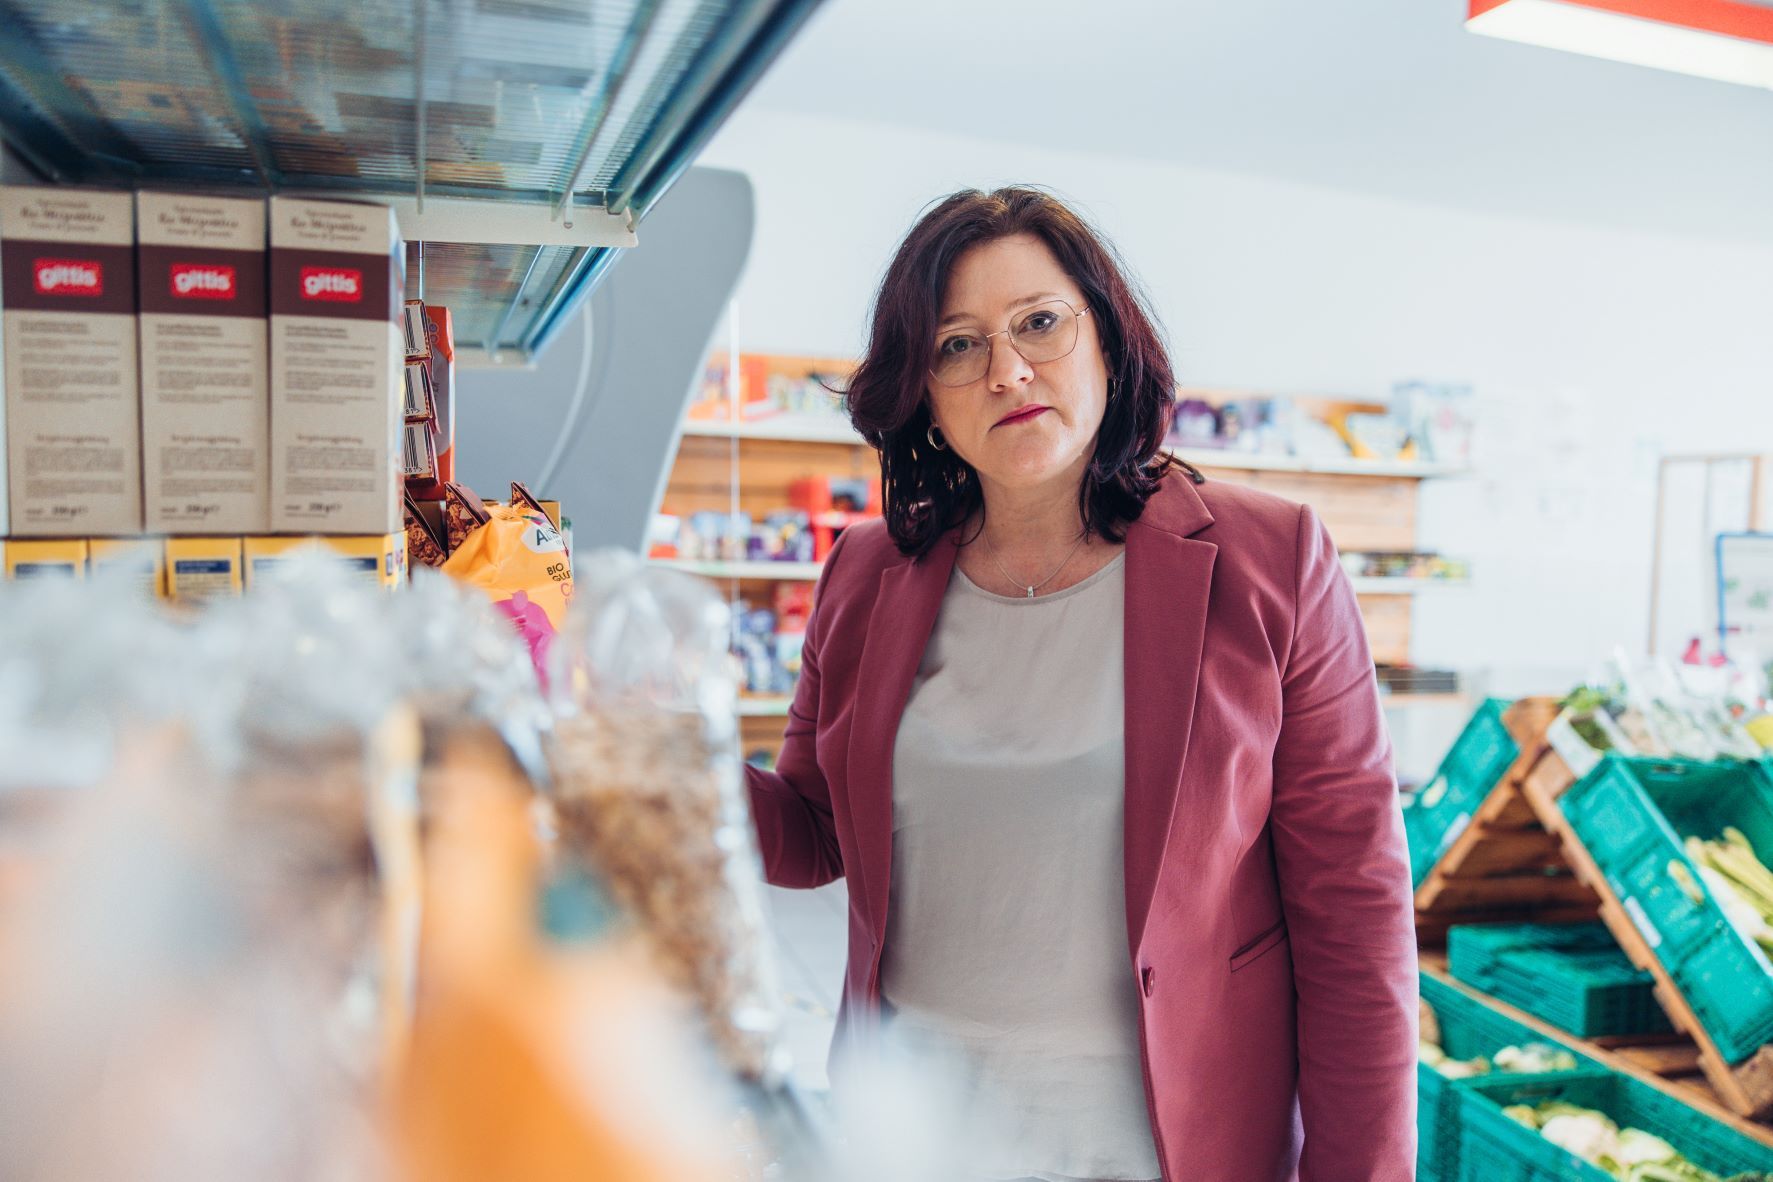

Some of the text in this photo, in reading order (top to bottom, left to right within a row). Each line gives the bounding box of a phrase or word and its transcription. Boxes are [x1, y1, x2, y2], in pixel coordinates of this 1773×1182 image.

[38, 265, 97, 289] gittis
[174, 269, 231, 293] gittis
[304, 273, 357, 295] gittis
[546, 562, 564, 576] BIO
